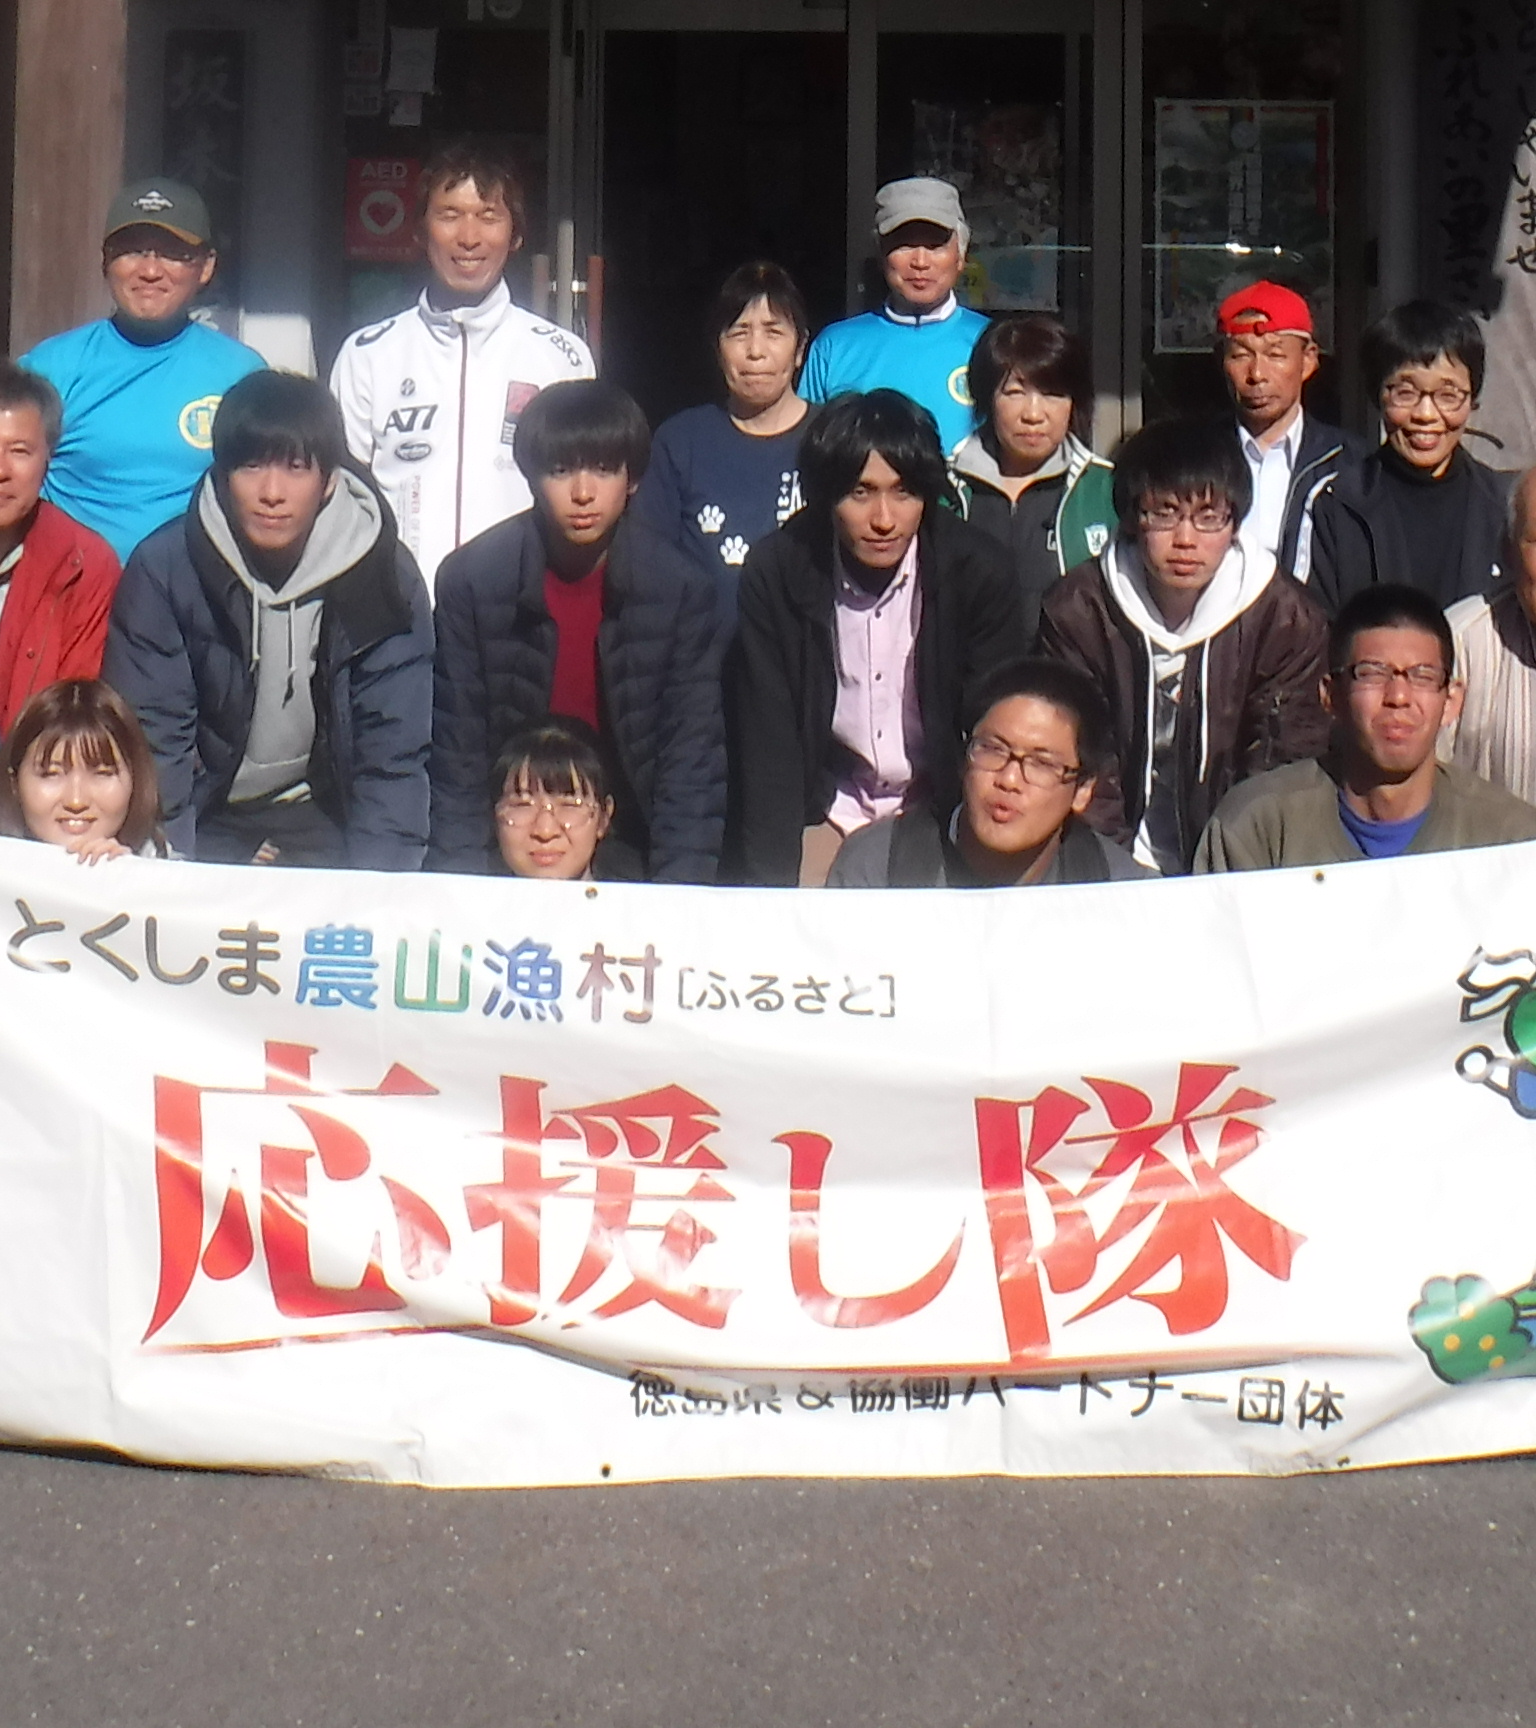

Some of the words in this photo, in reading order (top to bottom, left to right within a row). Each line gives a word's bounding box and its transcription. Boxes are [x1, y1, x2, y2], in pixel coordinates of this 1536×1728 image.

[360, 161, 408, 179] AED
[1433, 7, 1499, 305] ふれあいの里さ
[550, 333, 583, 367] asics
[143, 1041, 1308, 1362] 応援し隊
